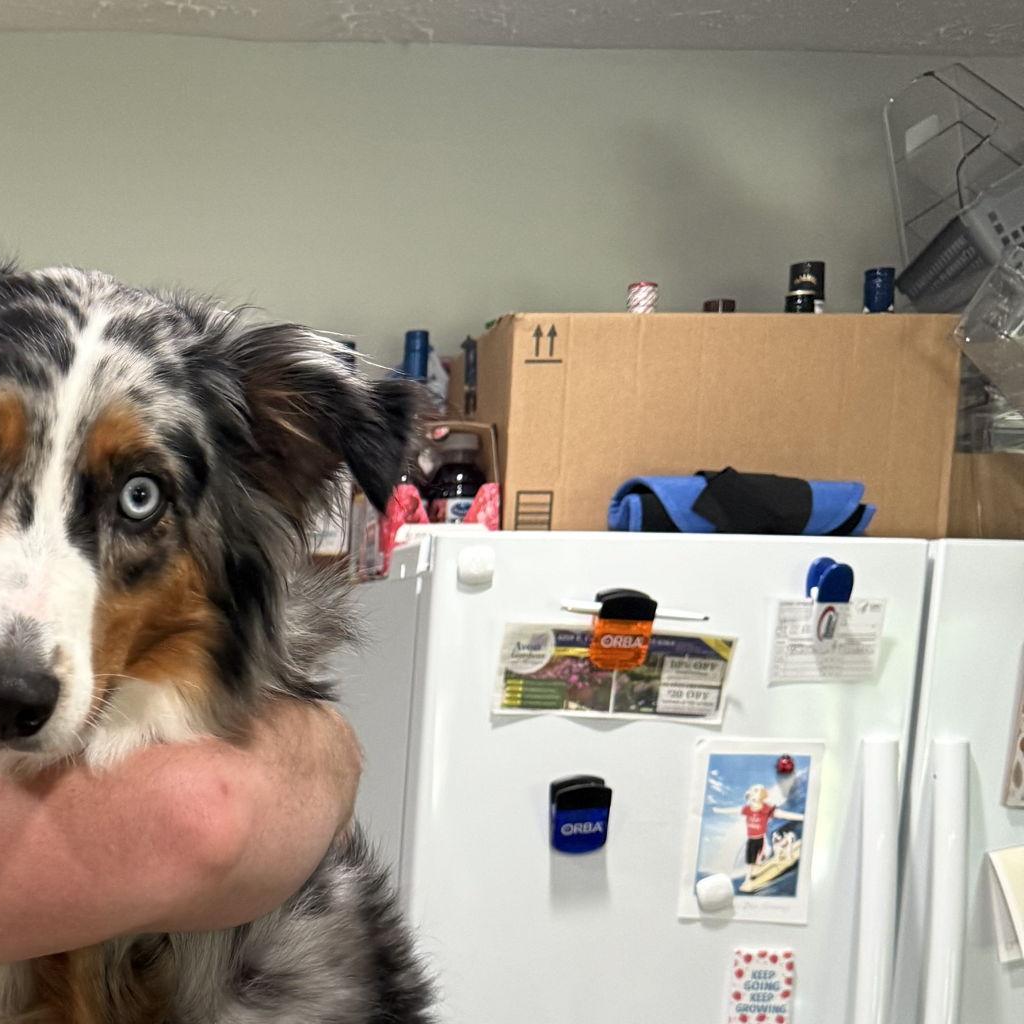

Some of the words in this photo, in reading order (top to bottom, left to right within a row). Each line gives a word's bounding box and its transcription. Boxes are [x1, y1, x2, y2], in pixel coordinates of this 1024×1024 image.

[600, 634, 643, 649] ORBA
[560, 821, 603, 836] ORBA
[751, 969, 776, 980] KEEP
[743, 980, 780, 991] GOING
[750, 992, 774, 1002] KEEP
[735, 1003, 786, 1013] GROWING
